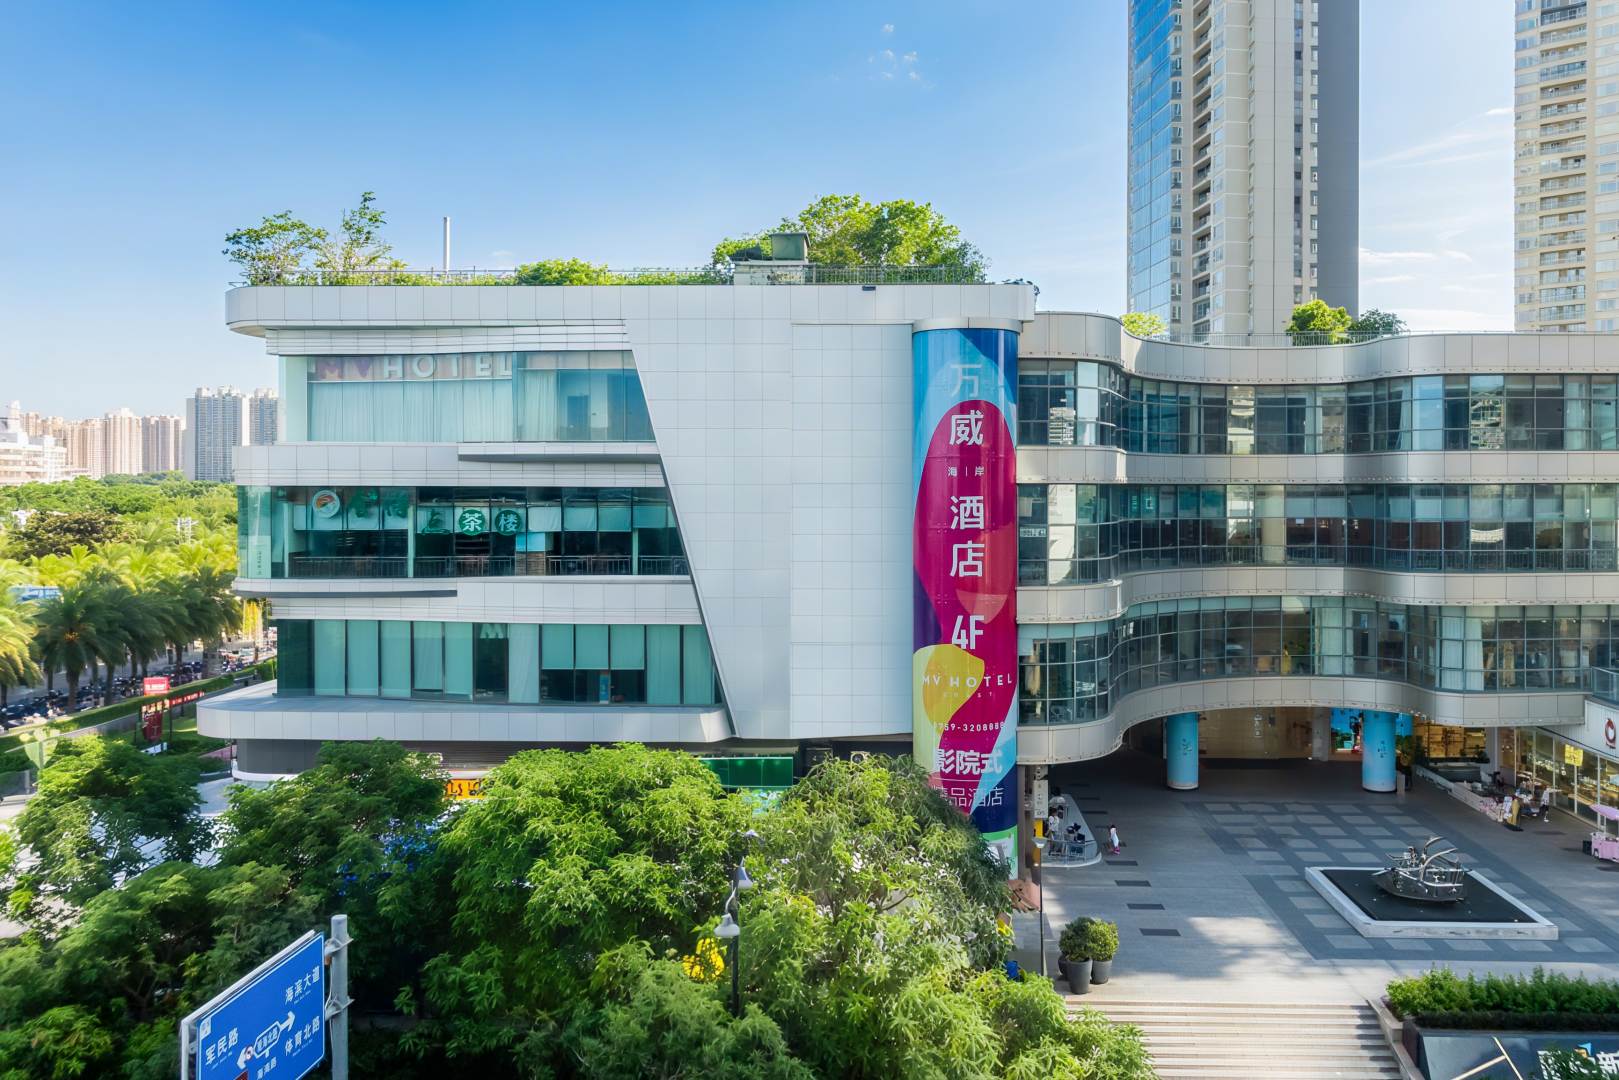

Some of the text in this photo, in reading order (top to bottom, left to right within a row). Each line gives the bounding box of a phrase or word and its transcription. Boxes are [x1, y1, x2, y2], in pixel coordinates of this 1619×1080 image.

[951, 615, 985, 649] 4F
[950, 673, 1012, 688] HOTEL
[936, 749, 1002, 775] 影院式
[205, 1027, 239, 1066] 军民路
